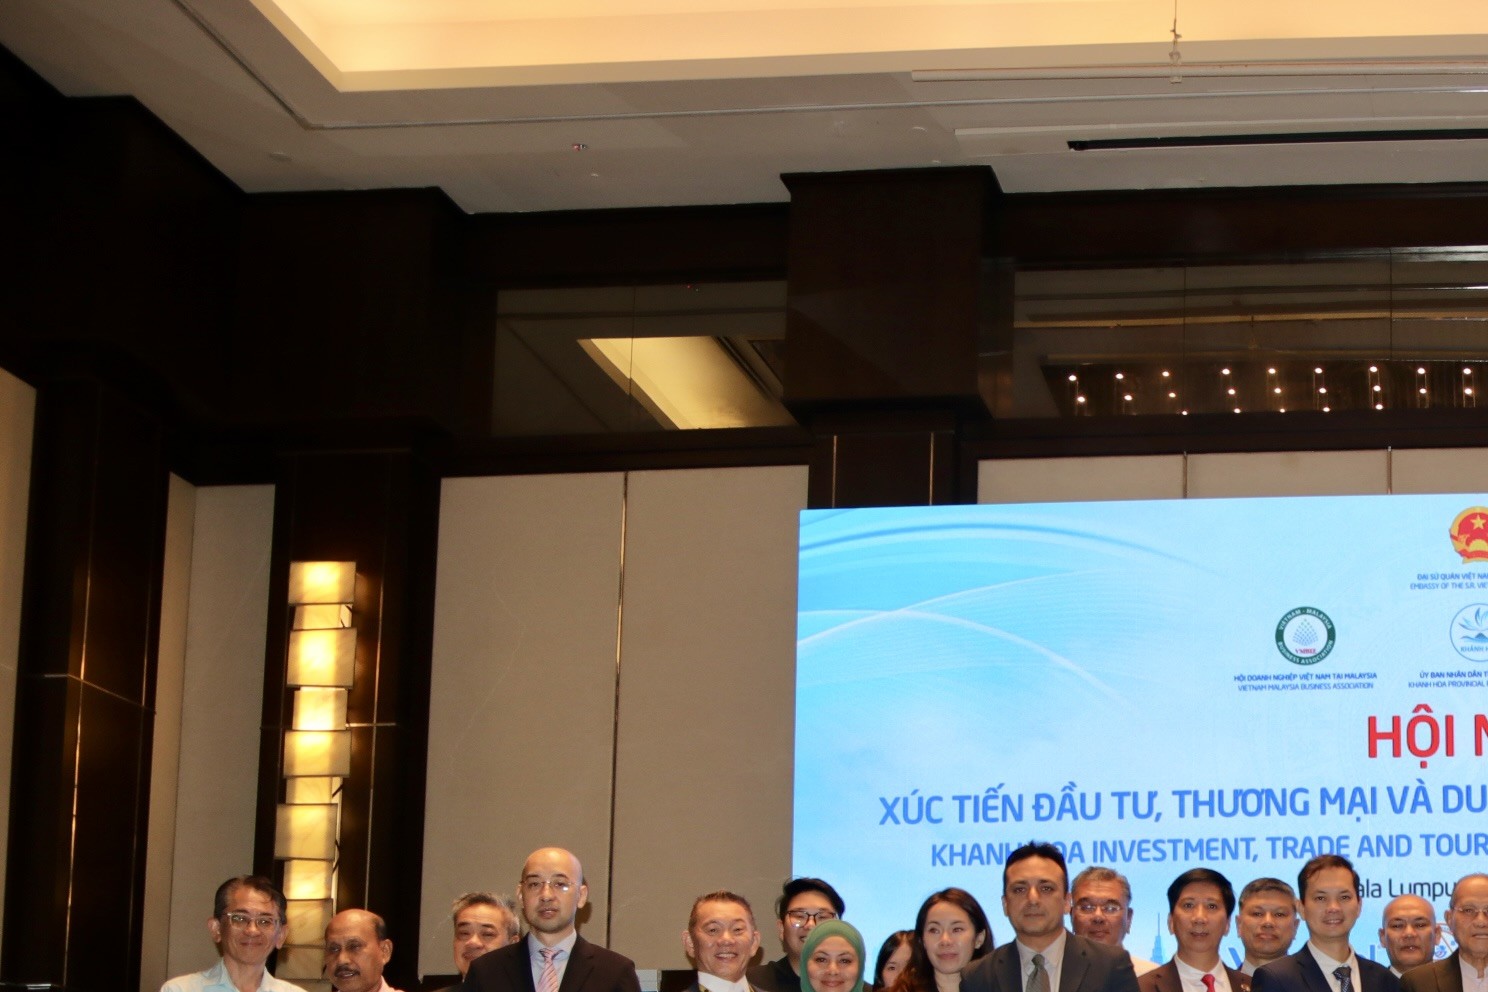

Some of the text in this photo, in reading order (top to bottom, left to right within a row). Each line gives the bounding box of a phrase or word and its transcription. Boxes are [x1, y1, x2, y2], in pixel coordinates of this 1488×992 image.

[1238, 684, 1266, 692] VIETNAM
[1301, 682, 1331, 690] BUSINESS
[1332, 682, 1374, 690] ASSOCIATION
[1248, 674, 1272, 682] DOANH
[1344, 672, 1377, 680] MALAYSIA
[1368, 703, 1455, 768] HỘI
[878, 788, 944, 826] XÚC
[951, 782, 1024, 824] TIẾN
[1031, 781, 1102, 822] ĐẦU
[1110, 790, 1162, 823] TƯ,
[1171, 787, 1310, 819] THƯƠNG
[1319, 786, 1378, 823] MẠI
[1386, 778, 1433, 815] VÀ
[1442, 784, 1488, 814] DU
[1092, 837, 1259, 863] INVESTMENT,
[1265, 836, 1350, 859] TRADE
[1356, 834, 1413, 858] AND
[1388, 877, 1456, 901] Lumpu
